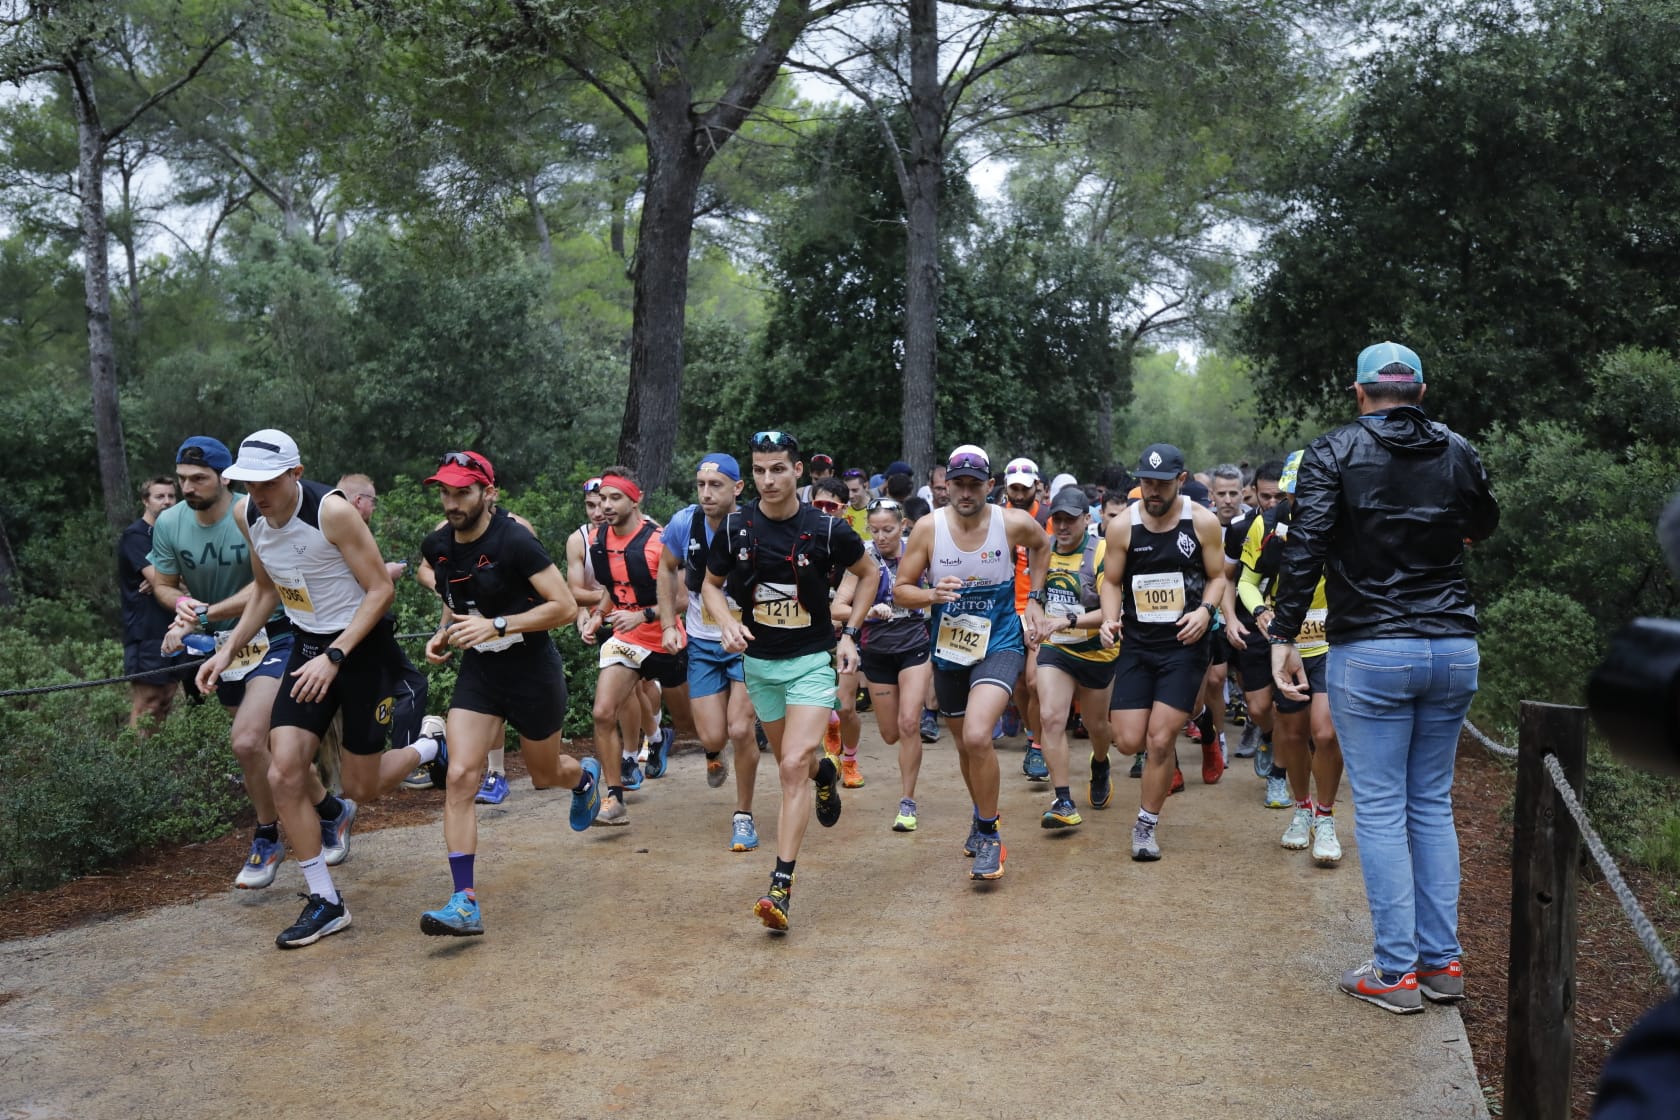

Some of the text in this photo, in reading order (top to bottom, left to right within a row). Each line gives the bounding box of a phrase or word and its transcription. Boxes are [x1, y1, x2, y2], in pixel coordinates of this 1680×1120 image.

[1047, 587, 1074, 596] OCTOBER
[1047, 592, 1077, 605] TRAIL
[1145, 589, 1175, 604] 1001
[765, 601, 799, 617] 1211
[946, 599, 996, 612] TRITON
[1302, 620, 1327, 634] 318
[951, 628, 980, 647] 1142
